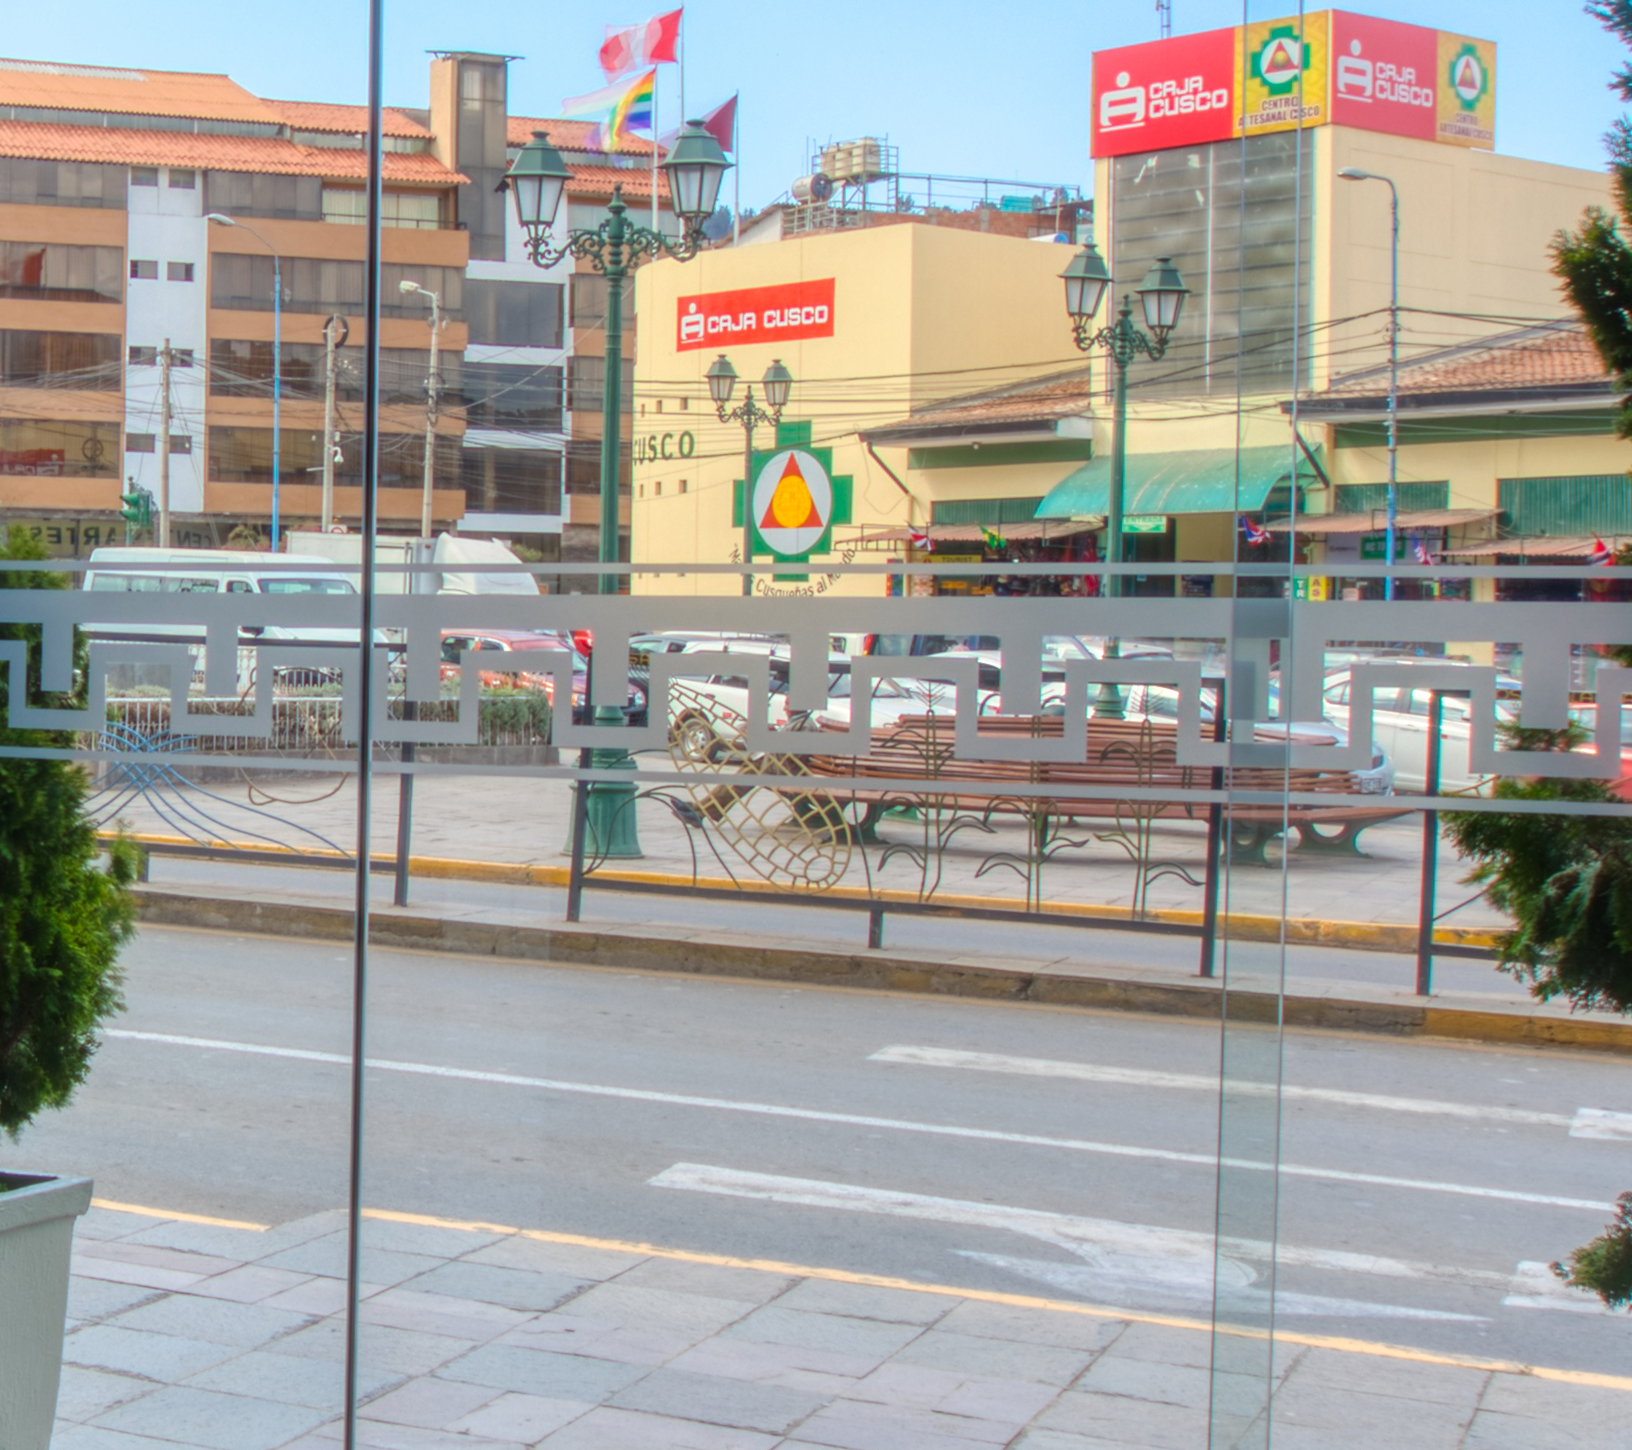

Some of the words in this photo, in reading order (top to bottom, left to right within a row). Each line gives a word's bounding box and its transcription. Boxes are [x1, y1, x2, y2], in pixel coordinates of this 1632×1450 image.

[1376, 62, 1416, 85] CAJA
[1149, 75, 1203, 99] CAJA
[1375, 79, 1434, 108] CUSCO
[1149, 88, 1228, 119] CUSCO
[1238, 110, 1287, 128] ATESANAL
[1289, 104, 1321, 120] CSCO
[1261, 95, 1299, 111] CENTRO
[707, 312, 756, 334] CAJA
[763, 305, 829, 329] CUSCO
[634, 430, 695, 467] USCO
